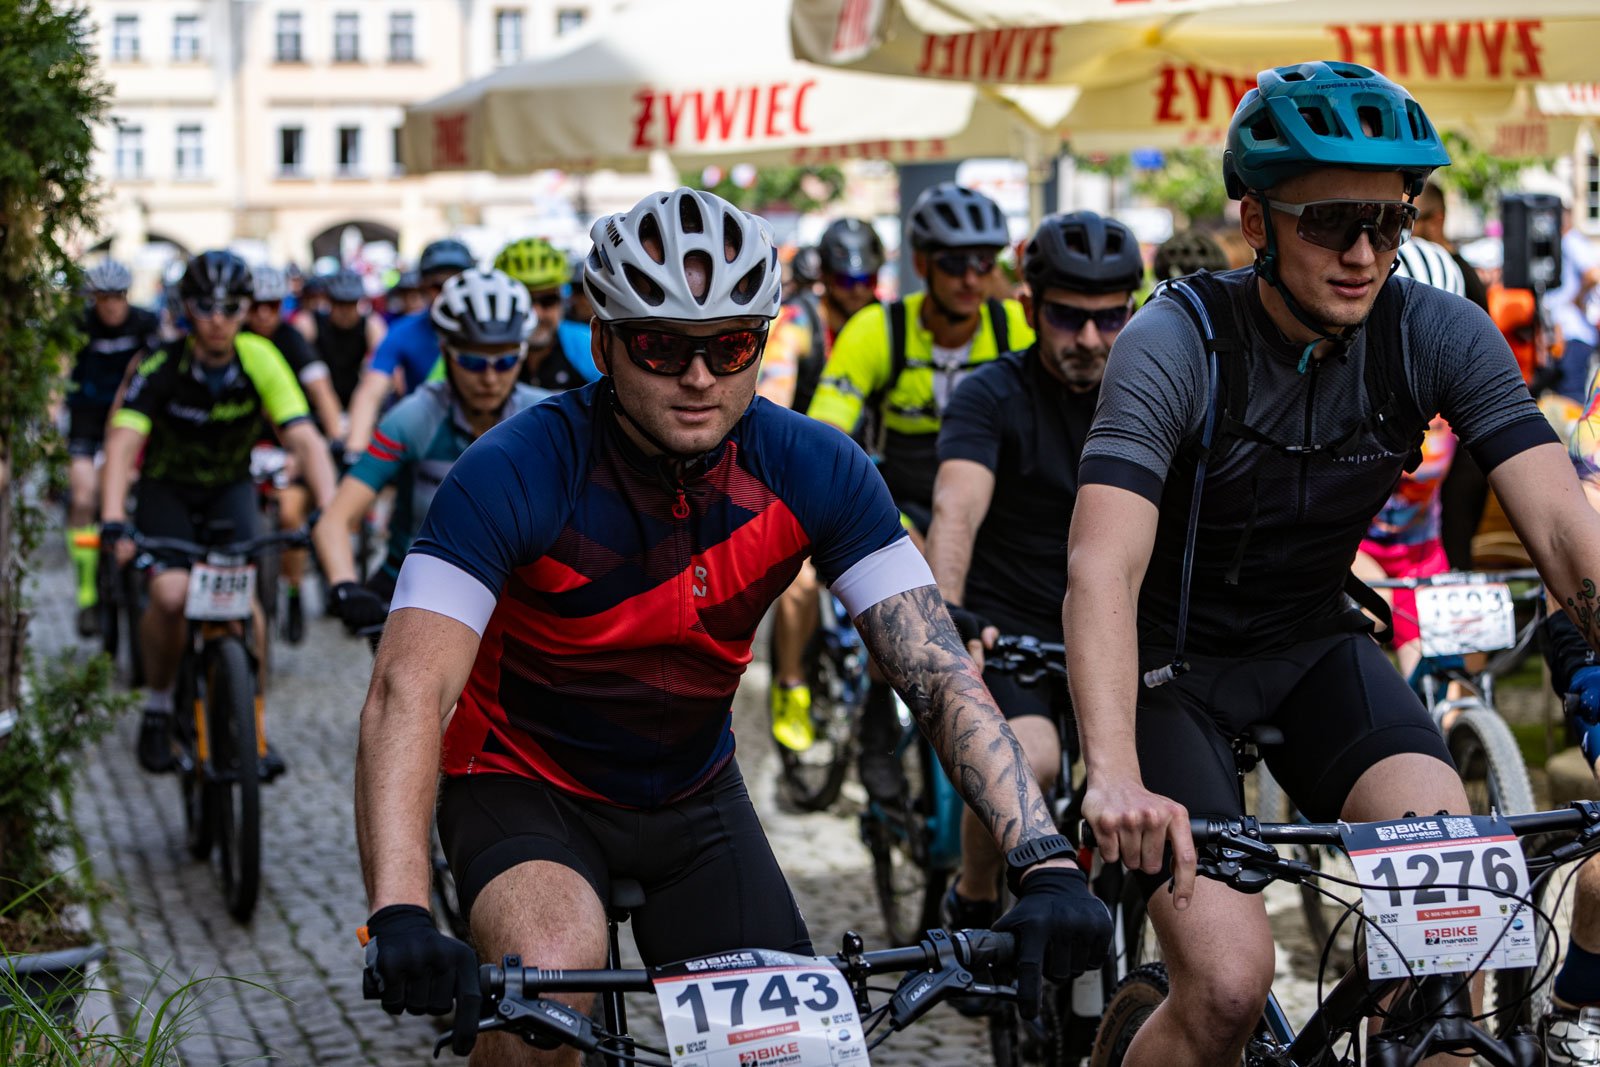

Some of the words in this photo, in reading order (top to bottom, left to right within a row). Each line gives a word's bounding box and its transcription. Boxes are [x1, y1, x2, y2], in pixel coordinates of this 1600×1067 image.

[1395, 821, 1440, 834] BIKE
[1371, 846, 1518, 907] 1276
[1441, 925, 1478, 938] BIKE
[675, 972, 839, 1035] 1743
[757, 1041, 800, 1060] BIKE
